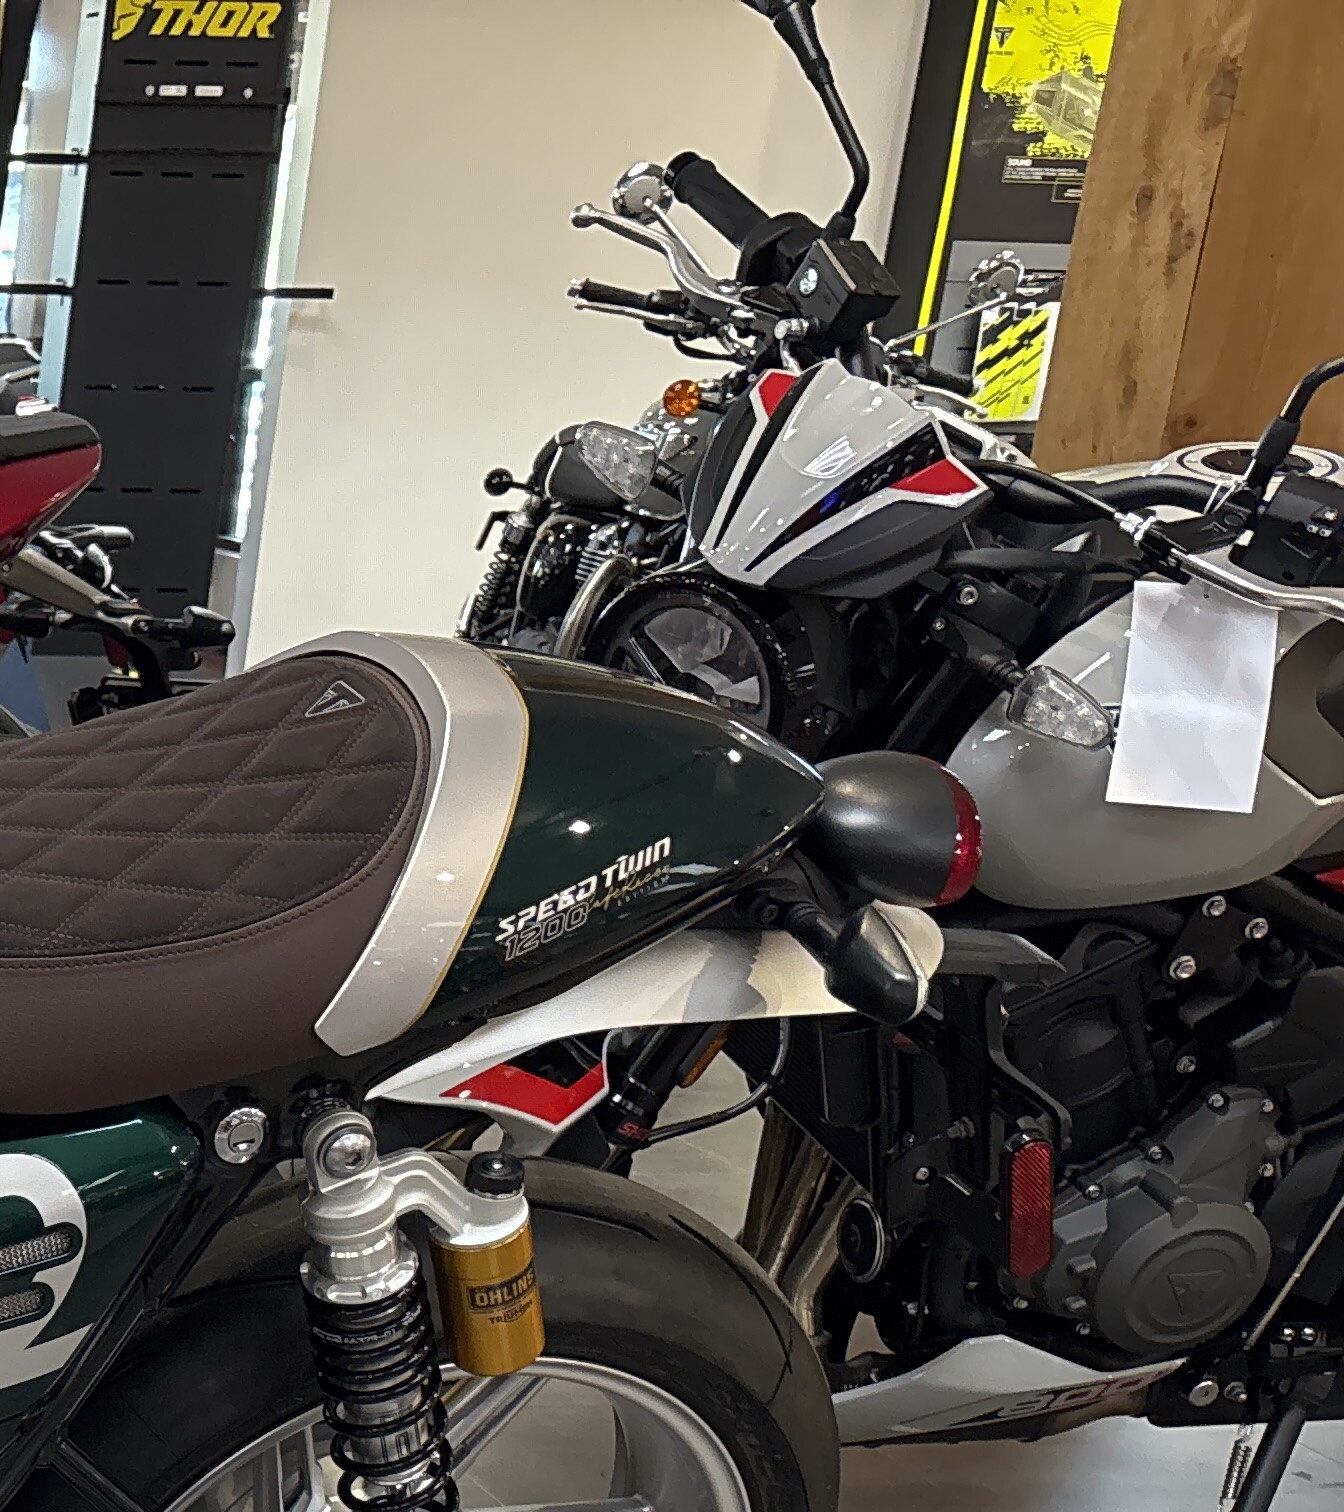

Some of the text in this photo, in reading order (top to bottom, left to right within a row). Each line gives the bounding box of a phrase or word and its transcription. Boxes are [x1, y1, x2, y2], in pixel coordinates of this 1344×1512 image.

[148, 2, 282, 38] THOR
[495, 836, 672, 932] SPEED TWIN
[505, 902, 590, 962] 1200
